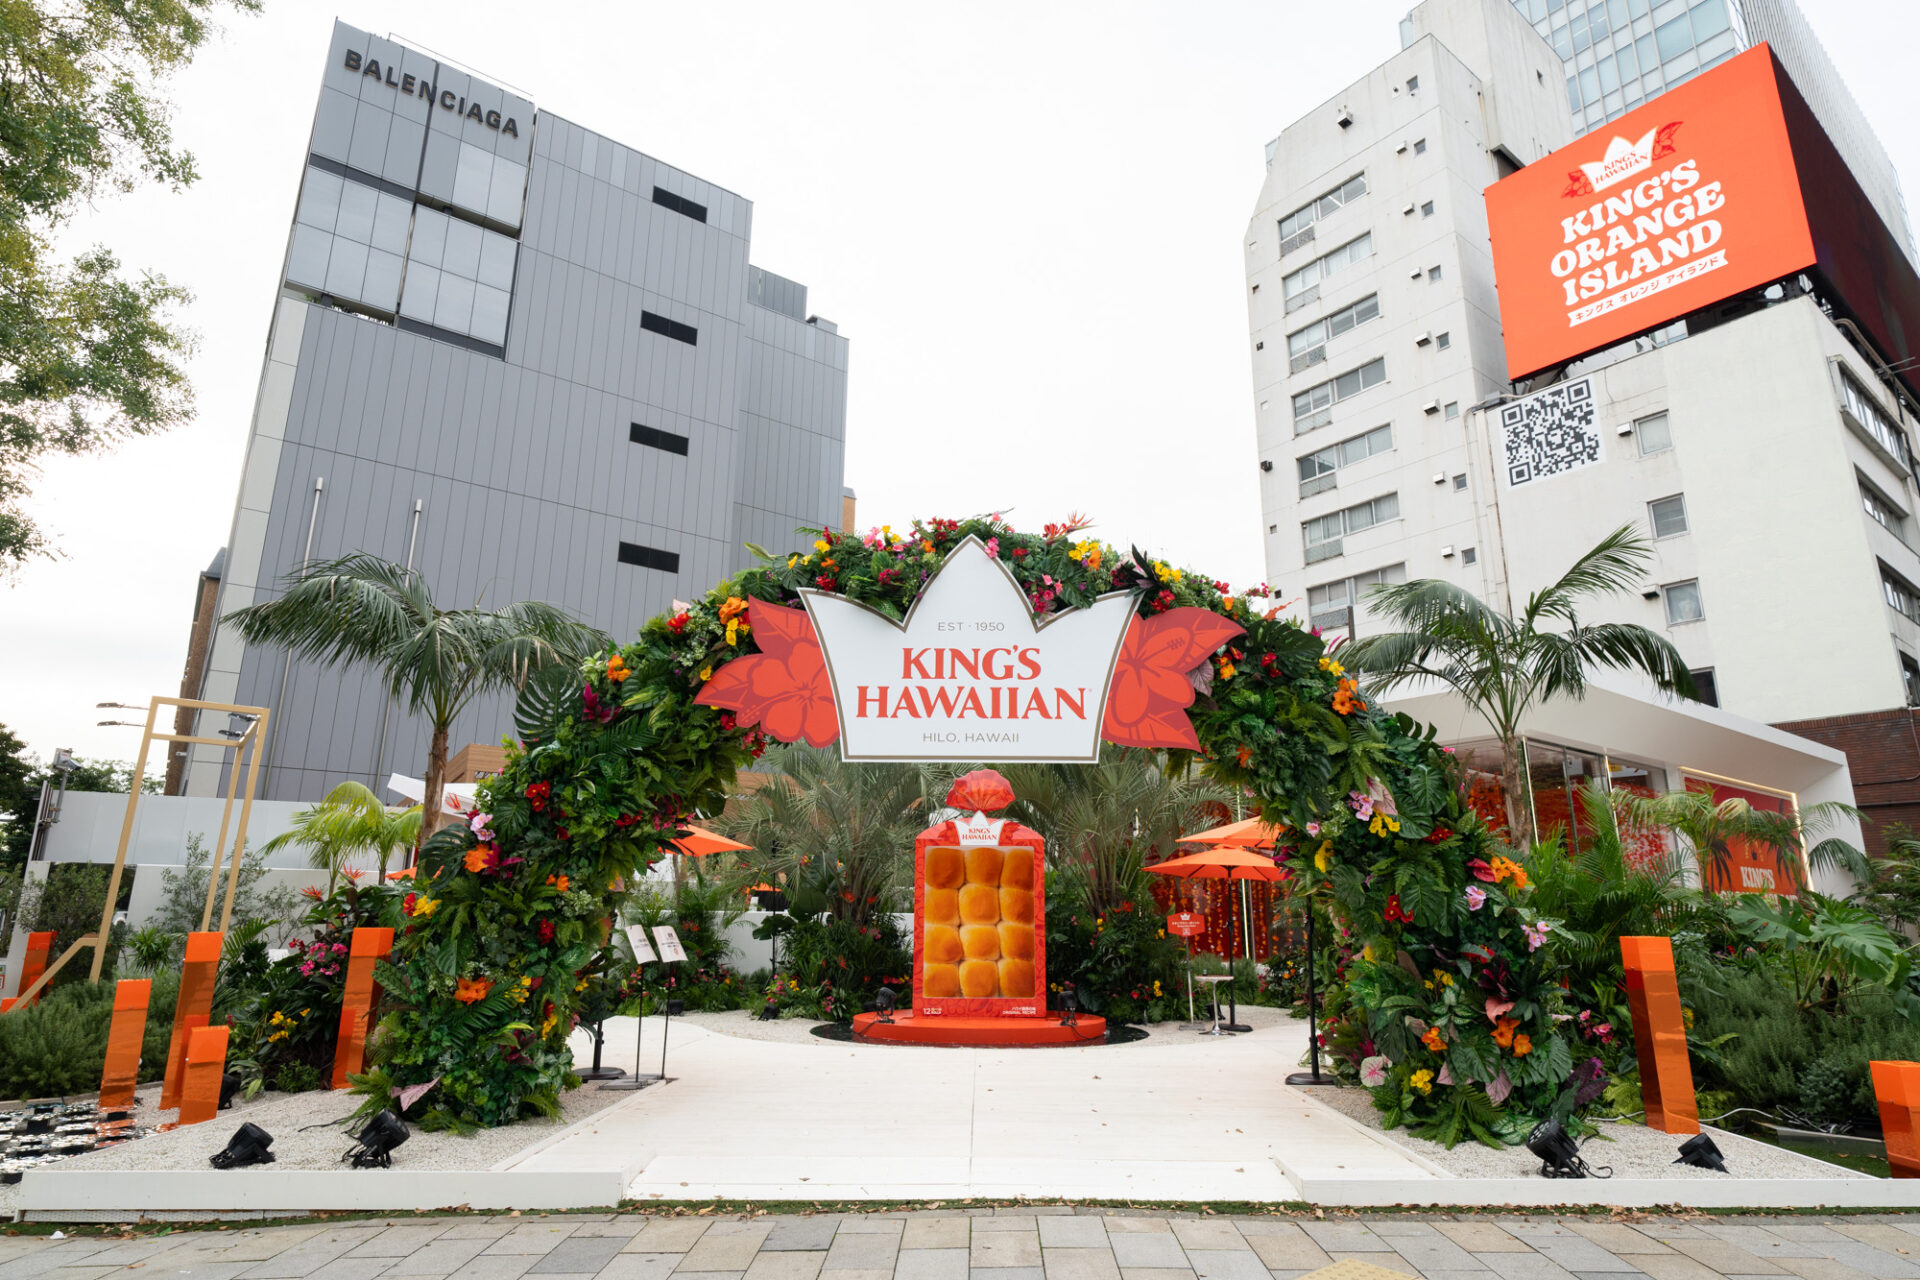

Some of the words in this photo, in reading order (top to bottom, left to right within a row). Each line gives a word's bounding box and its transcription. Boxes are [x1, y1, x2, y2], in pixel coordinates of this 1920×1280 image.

[344, 48, 519, 138] BALENCIAGA
[1595, 152, 1648, 184] HAWAIIAN
[1561, 158, 1700, 244] KING'S
[1550, 180, 1726, 278] ORANGE
[1562, 219, 1723, 306] ISLAND
[1575, 299, 1614, 321] キングス
[1619, 280, 1660, 303] オレンジ
[1666, 256, 1720, 284] アイランド
[937, 622, 964, 632] EST
[975, 622, 1005, 632] 1950
[901, 644, 1042, 681] KING'S
[856, 685, 1087, 720] HAWAIIAN
[922, 732, 961, 743] HILO,
[964, 732, 1020, 743] HAWAII
